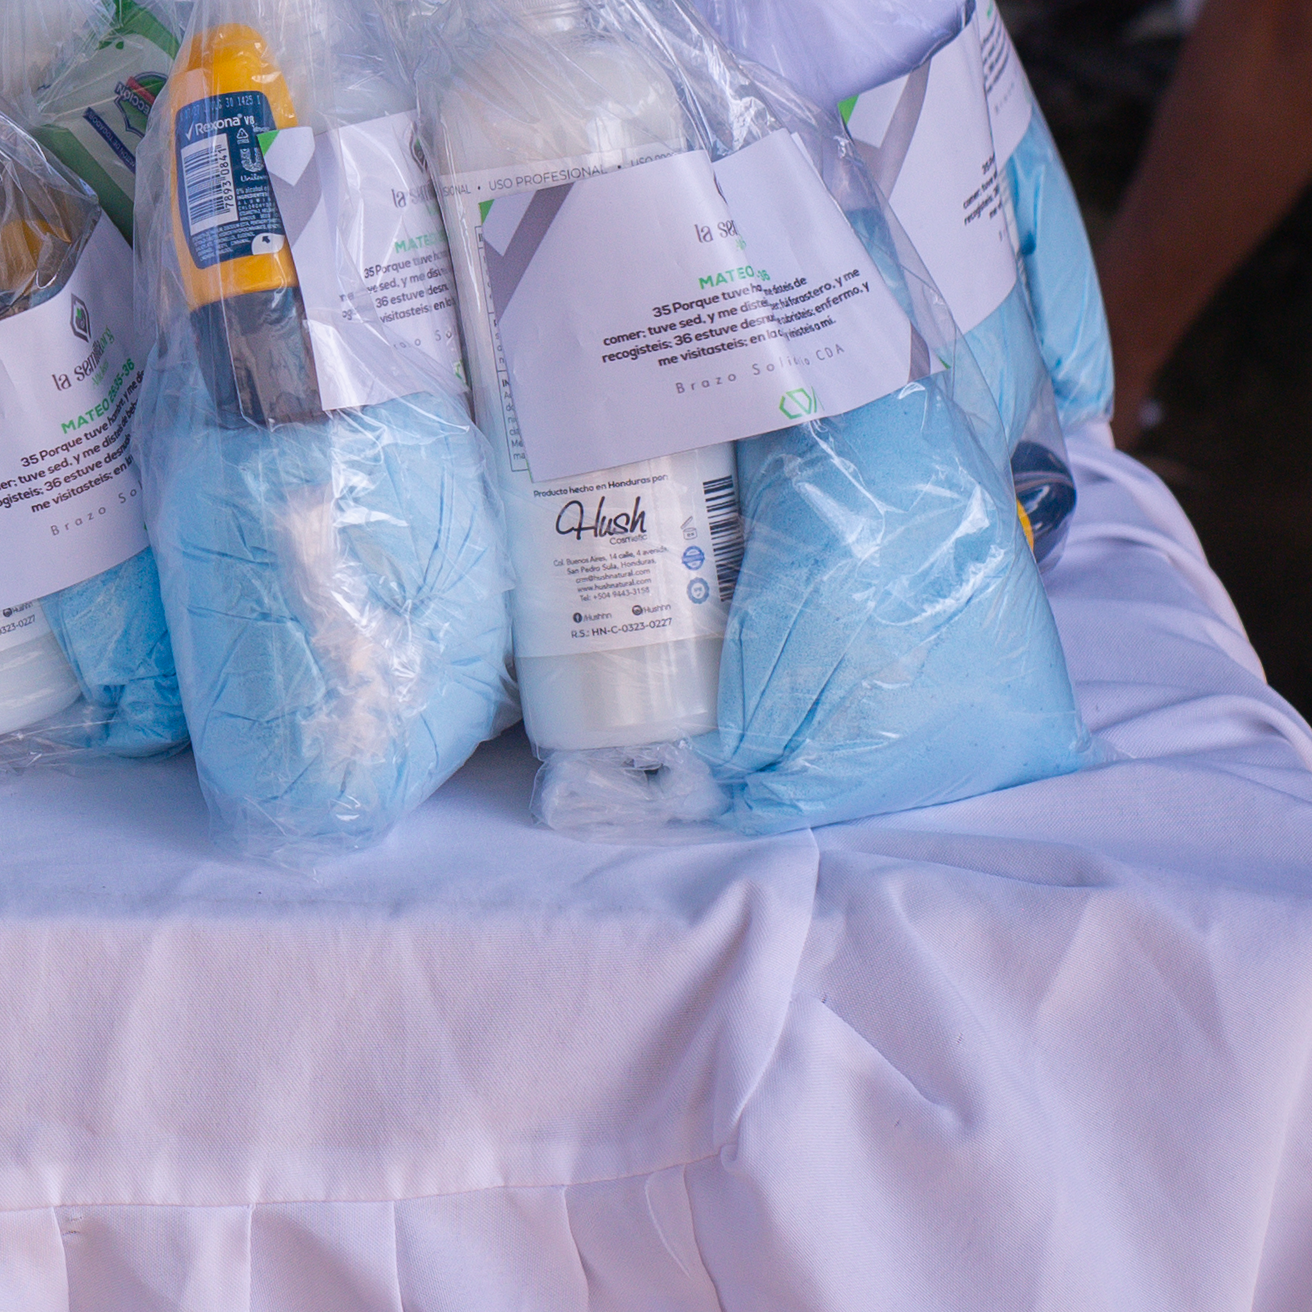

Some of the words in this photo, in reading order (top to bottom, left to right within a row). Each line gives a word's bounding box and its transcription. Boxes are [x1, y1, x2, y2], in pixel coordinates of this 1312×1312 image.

[195, 115, 241, 136] Rexona
[219, 147, 230, 176] 0841
[489, 178, 513, 191] USO
[516, 164, 610, 188] PROFESIONAL
[223, 181, 234, 209] 7893
[694, 224, 714, 243] la
[699, 265, 755, 289] MATEO
[652, 304, 672, 318] 35
[672, 295, 720, 313] Porque
[721, 288, 748, 300] tuve
[815, 344, 844, 361] CDA
[52, 374, 72, 391] la
[675, 374, 737, 394] Brazo
[61, 400, 108, 434] MATEO
[20, 454, 39, 467] 35
[39, 437, 82, 461] Porque
[84, 422, 109, 440] tuve
[50, 507, 107, 536] Brazo
[555, 496, 647, 541] Hush
